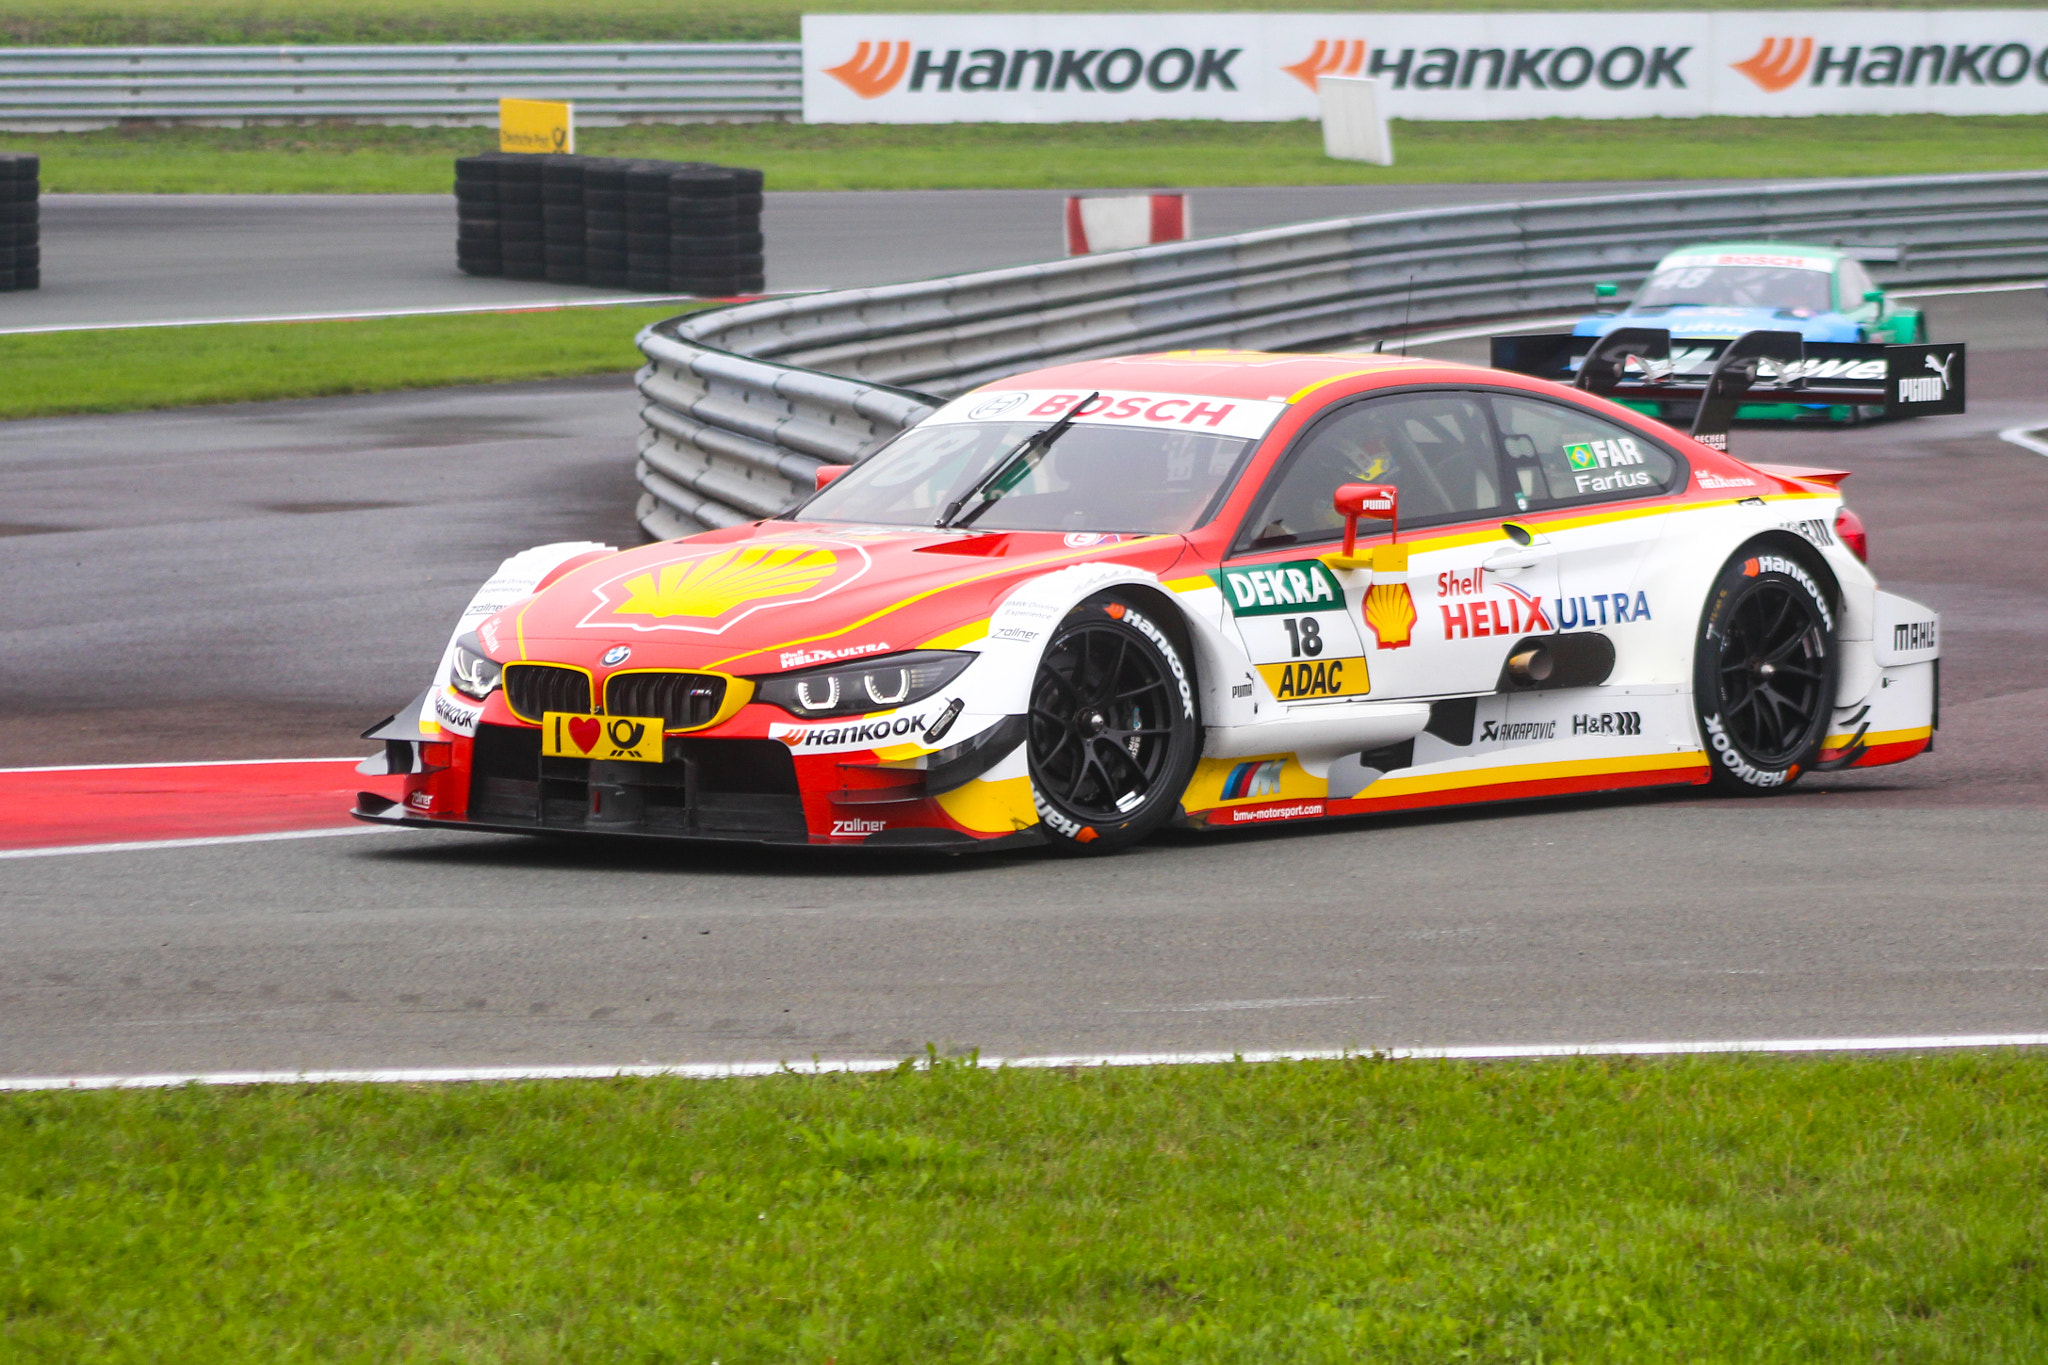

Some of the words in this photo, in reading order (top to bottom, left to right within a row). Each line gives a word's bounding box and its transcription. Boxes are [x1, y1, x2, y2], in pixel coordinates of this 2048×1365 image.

[1718, 255, 1804, 267] BOSCH
[1899, 377, 1943, 402] PUMA
[1027, 394, 1236, 427] BOSCH
[1591, 437, 1645, 469] FAR
[1574, 471, 1651, 494] Farfus
[1362, 499, 1391, 511] PUMA
[1226, 564, 1336, 608] DEKRA
[1437, 567, 1485, 599] Shell
[1004, 608, 1053, 620] Experience
[1027, 601, 1060, 613] Driving
[1438, 595, 1555, 641] HELIX
[1555, 589, 1652, 631] ULTRA
[1282, 616, 1323, 658] 18
[1894, 620, 1935, 651] MAHLE
[780, 650, 804, 660] Shell
[780, 649, 838, 669] HELIX
[836, 642, 890, 658] ULTRA
[1277, 658, 1345, 698] ADAC
[1231, 683, 1253, 699] PUMA
[1573, 712, 1614, 735] H&R
[1233, 804, 1322, 821] bmw-motorsport.com
